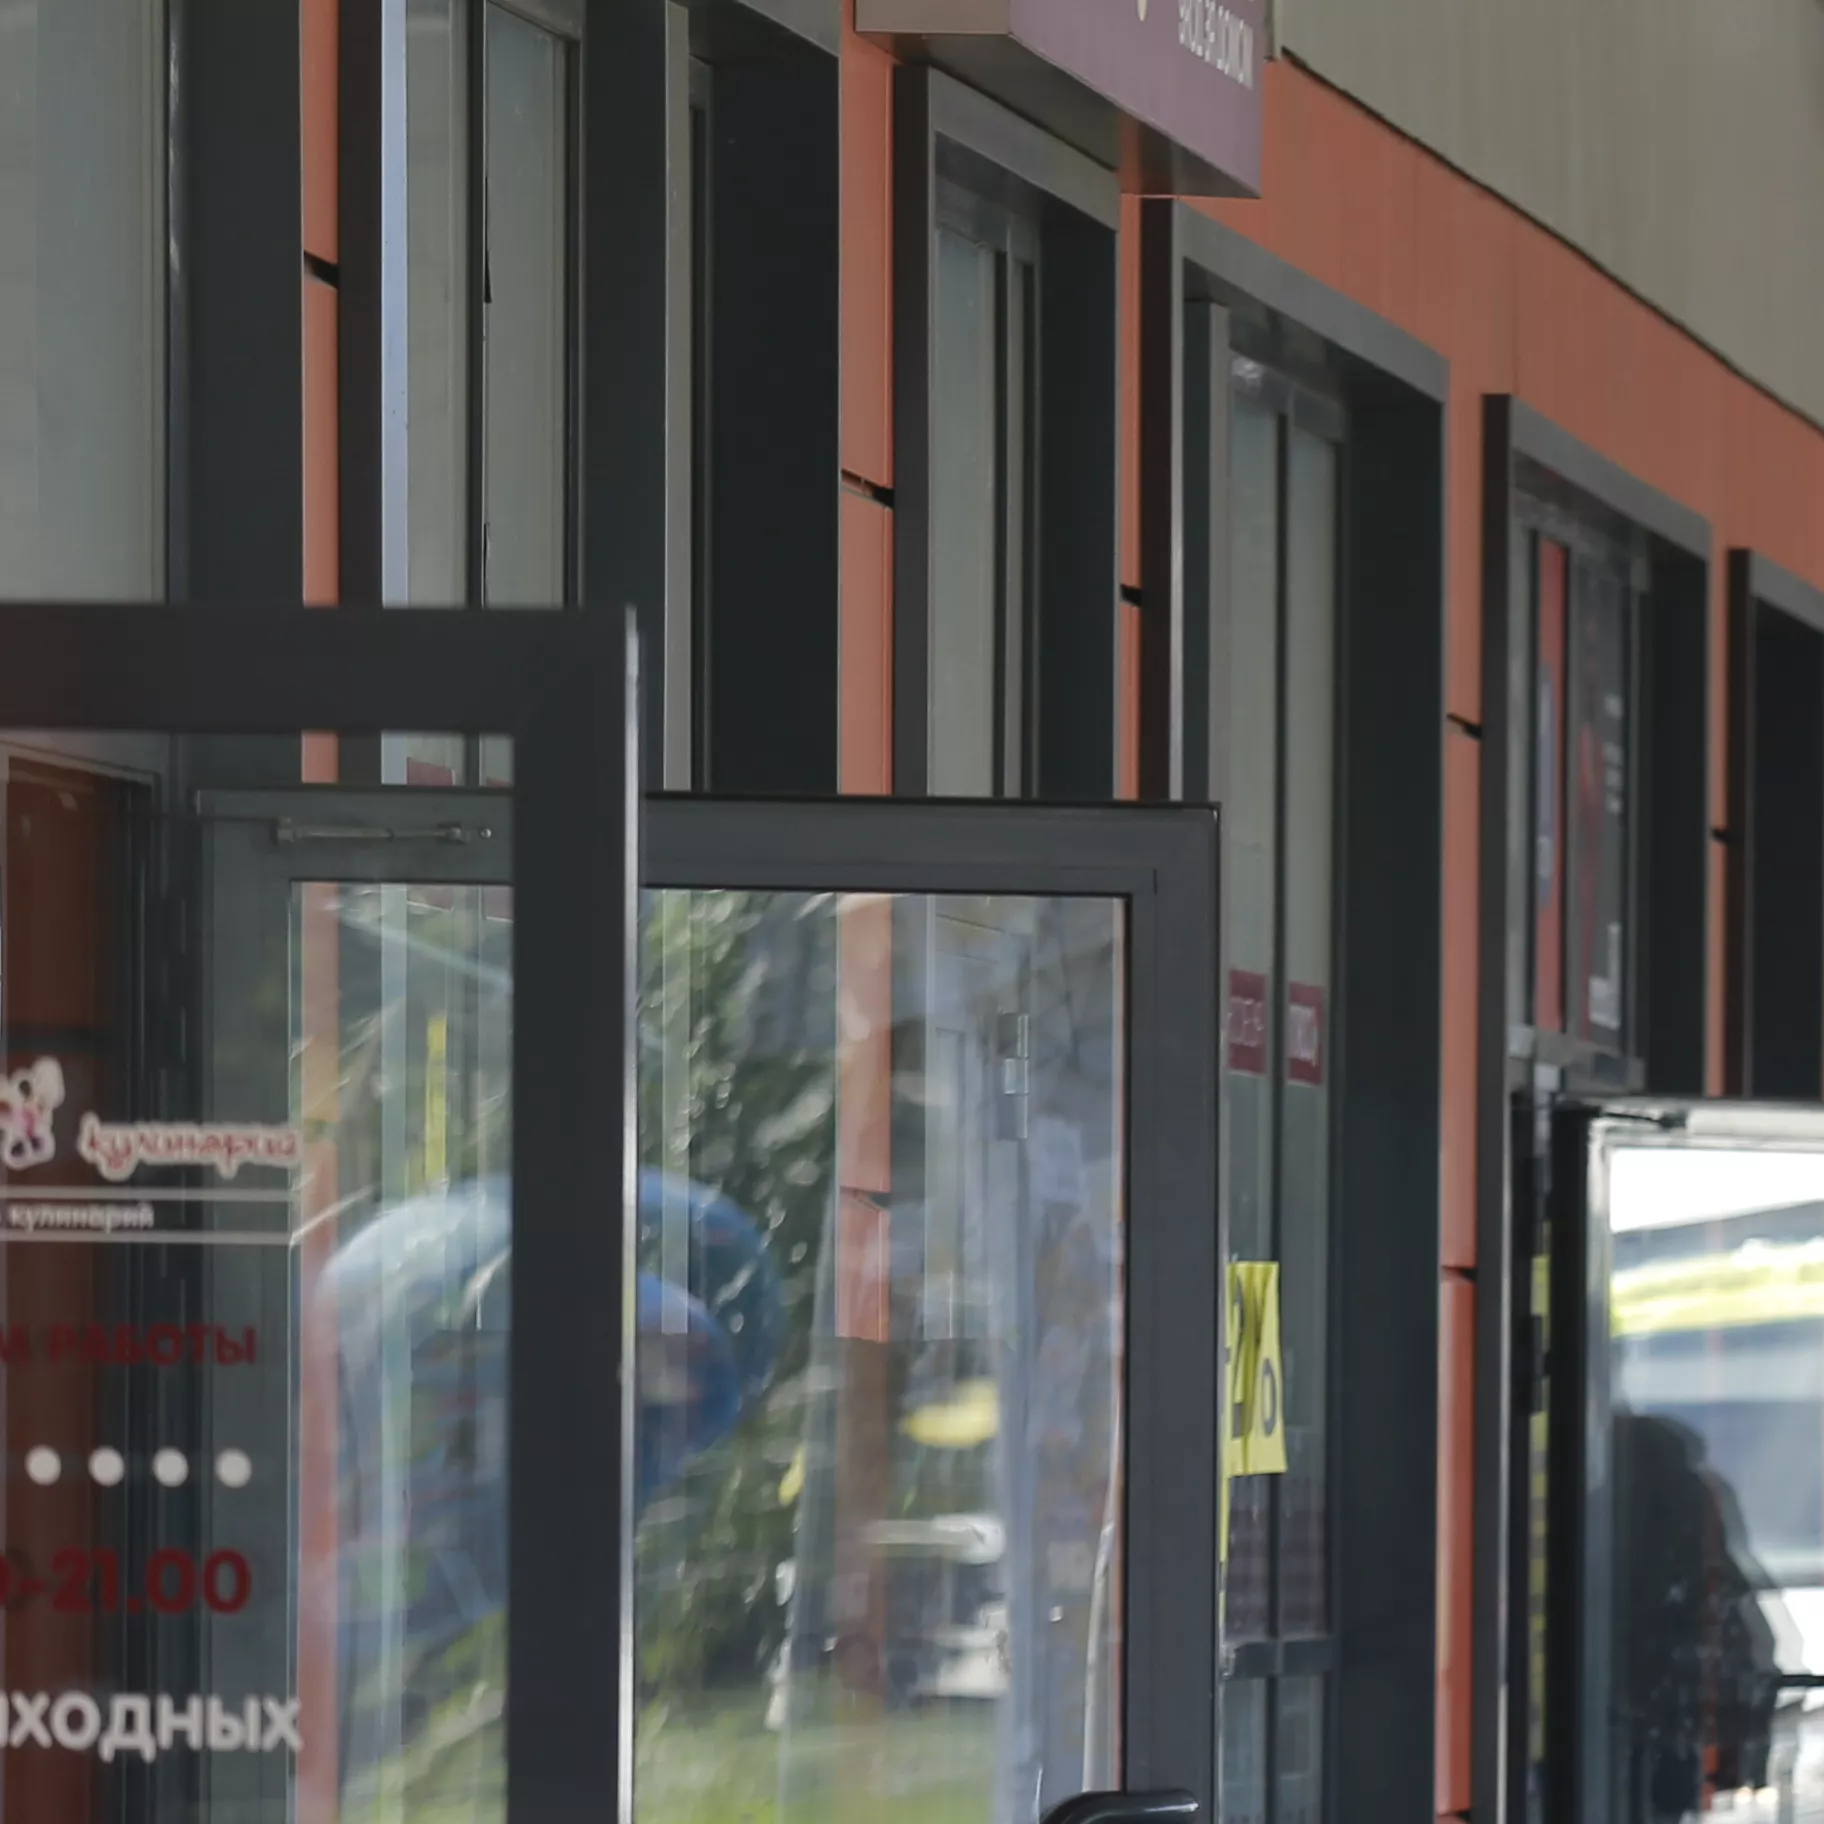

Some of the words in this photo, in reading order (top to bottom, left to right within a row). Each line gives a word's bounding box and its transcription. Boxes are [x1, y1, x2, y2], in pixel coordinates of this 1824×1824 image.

[9, 1201, 155, 1234] кулинарий
[48, 1323, 257, 1367] РАБОТЫ
[0, 1545, 253, 1617] -21.00
